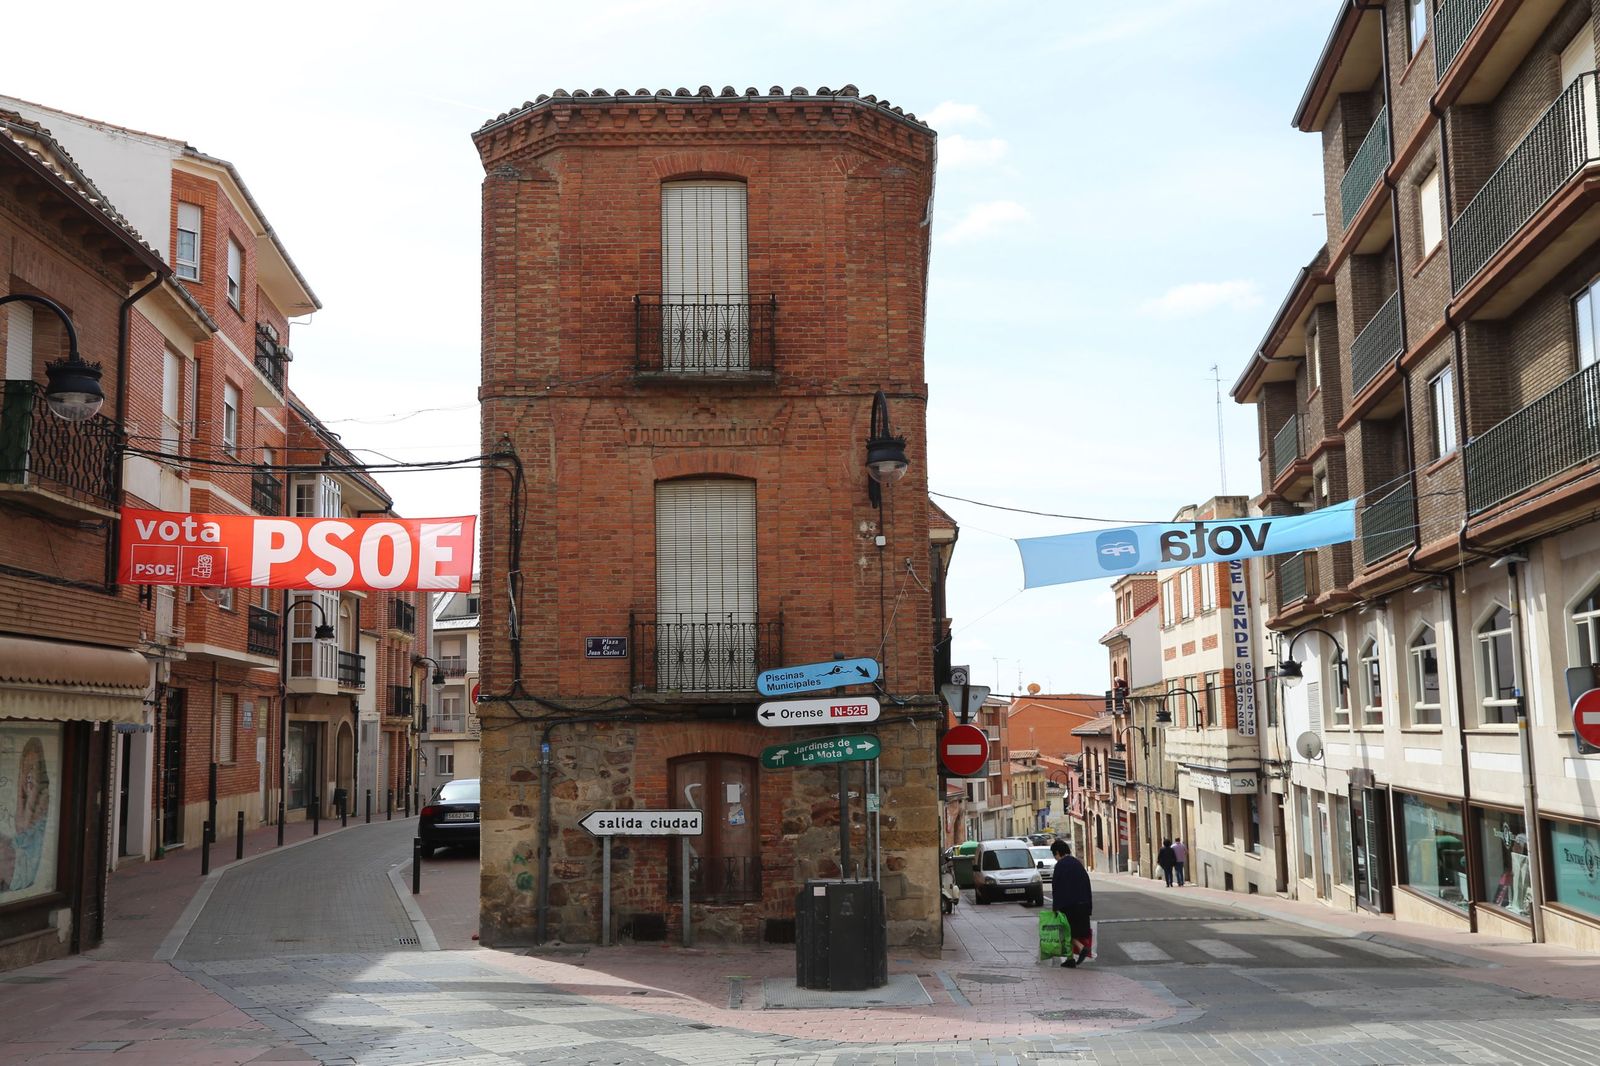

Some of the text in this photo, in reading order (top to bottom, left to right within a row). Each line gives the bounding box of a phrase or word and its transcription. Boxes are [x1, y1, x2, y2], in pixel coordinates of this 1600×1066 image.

[134, 515, 221, 543] vota
[251, 519, 463, 589] PSOE
[135, 563, 175, 576] PSOE
[1230, 559, 1249, 658] SE VENDE
[765, 671, 805, 682] Piscinas
[767, 678, 822, 692] Municipales
[780, 706, 867, 719] Orense N-525
[793, 739, 850, 755] Jardines de
[802, 750, 842, 761] La Mota
[598, 817, 698, 828] salida ciudad
